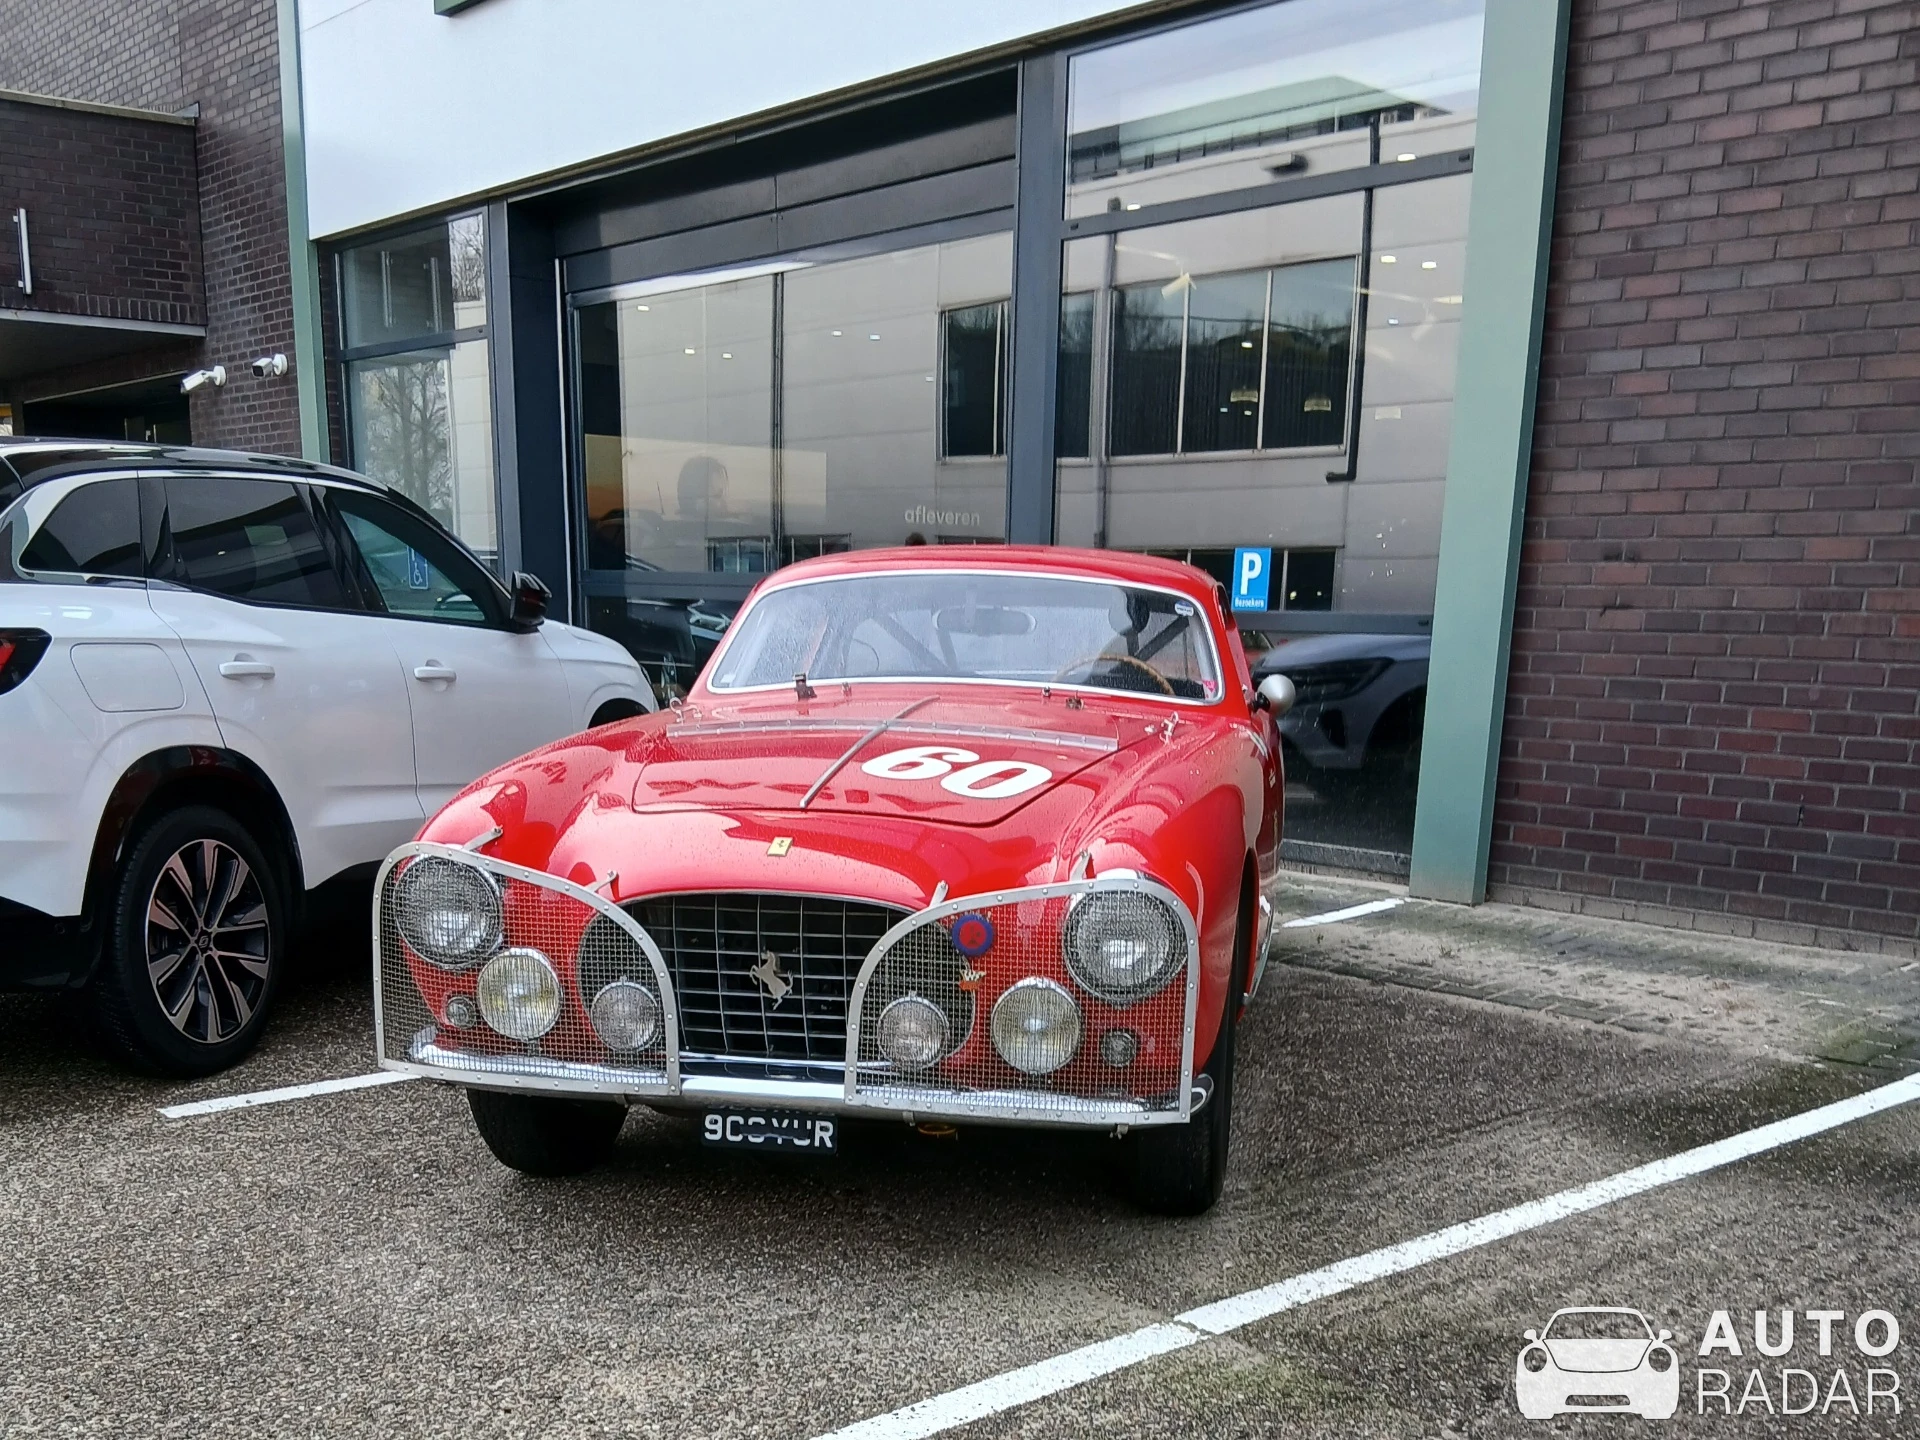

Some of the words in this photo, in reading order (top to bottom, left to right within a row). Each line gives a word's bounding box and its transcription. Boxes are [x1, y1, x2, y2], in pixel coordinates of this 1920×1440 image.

[904, 505, 980, 526] afleveren
[1240, 552, 1262, 595] P
[1234, 597, 1264, 608] Bezoekers
[861, 746, 1053, 799] 60
